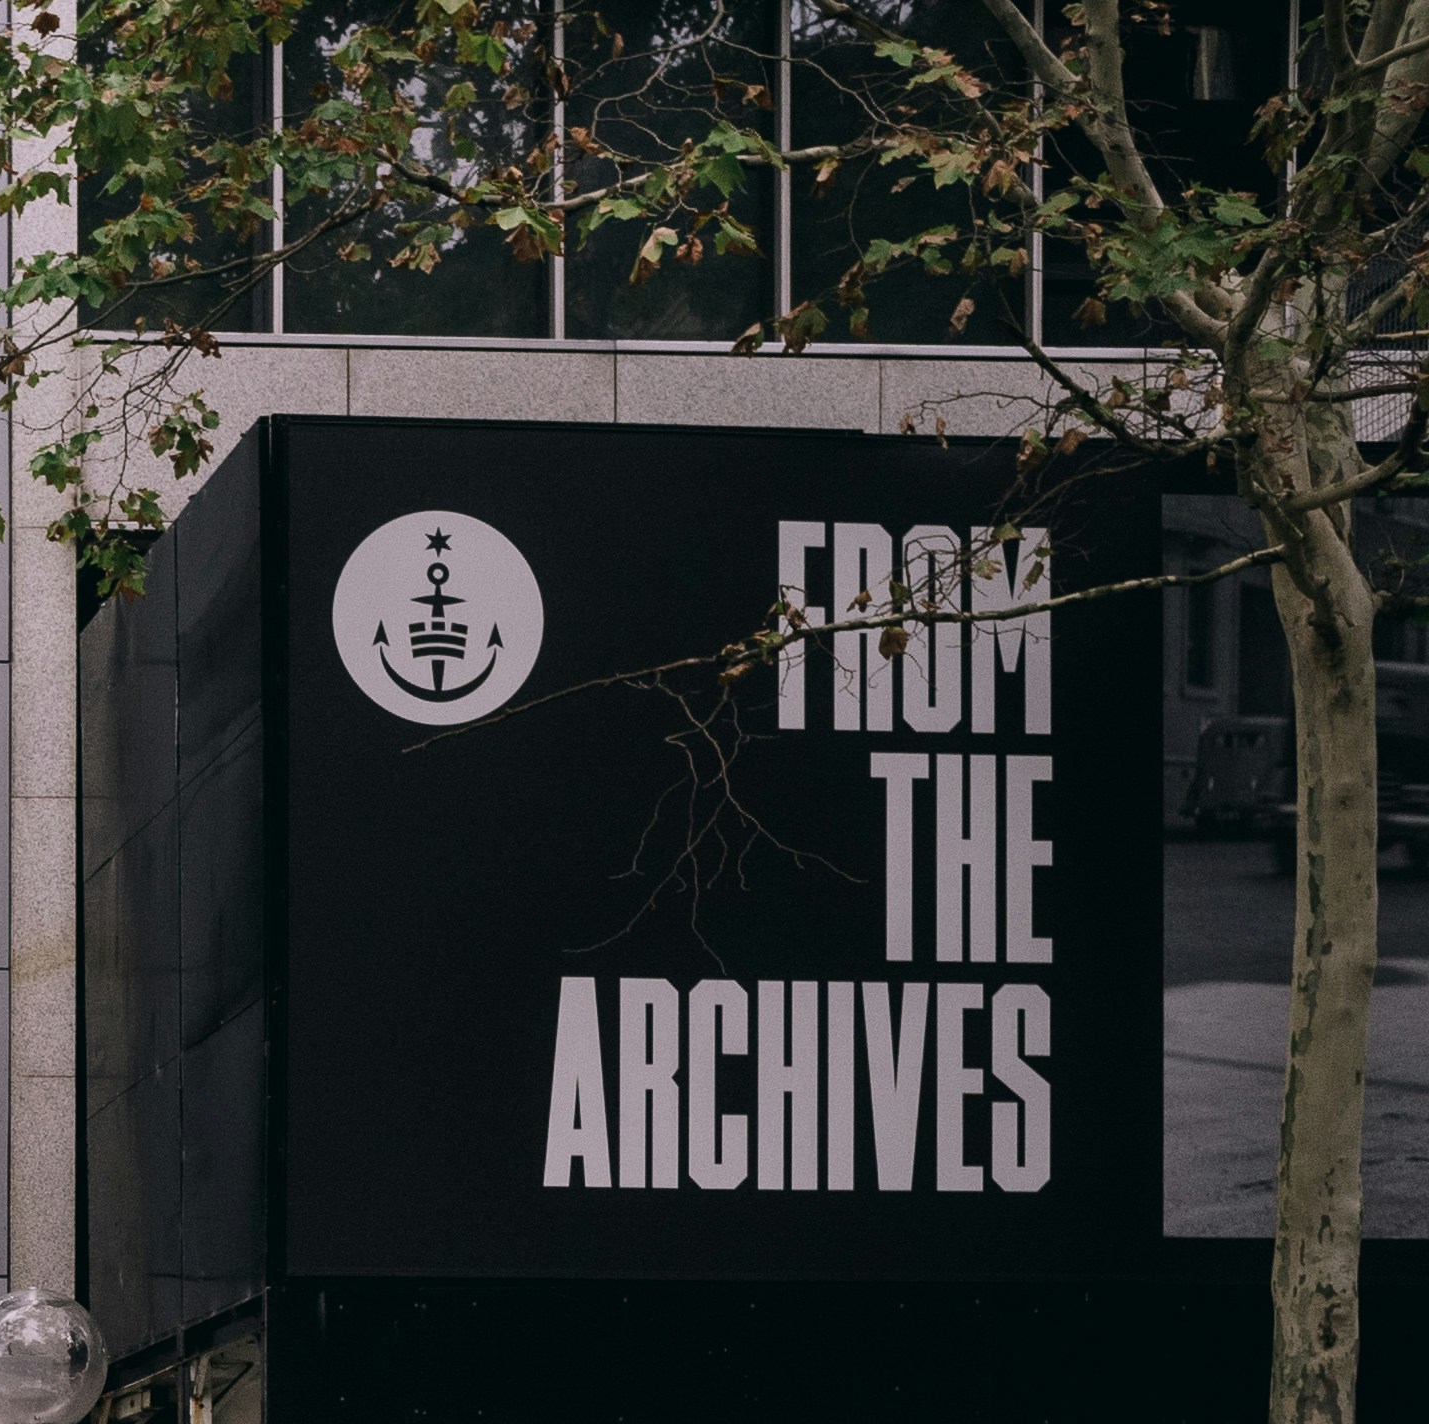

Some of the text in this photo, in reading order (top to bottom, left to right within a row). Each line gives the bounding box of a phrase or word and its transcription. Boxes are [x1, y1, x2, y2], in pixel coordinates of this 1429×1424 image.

[778, 521, 1052, 735] FROM
[870, 752, 1053, 963] THE
[542, 976, 1052, 1193] ARCHIVES
